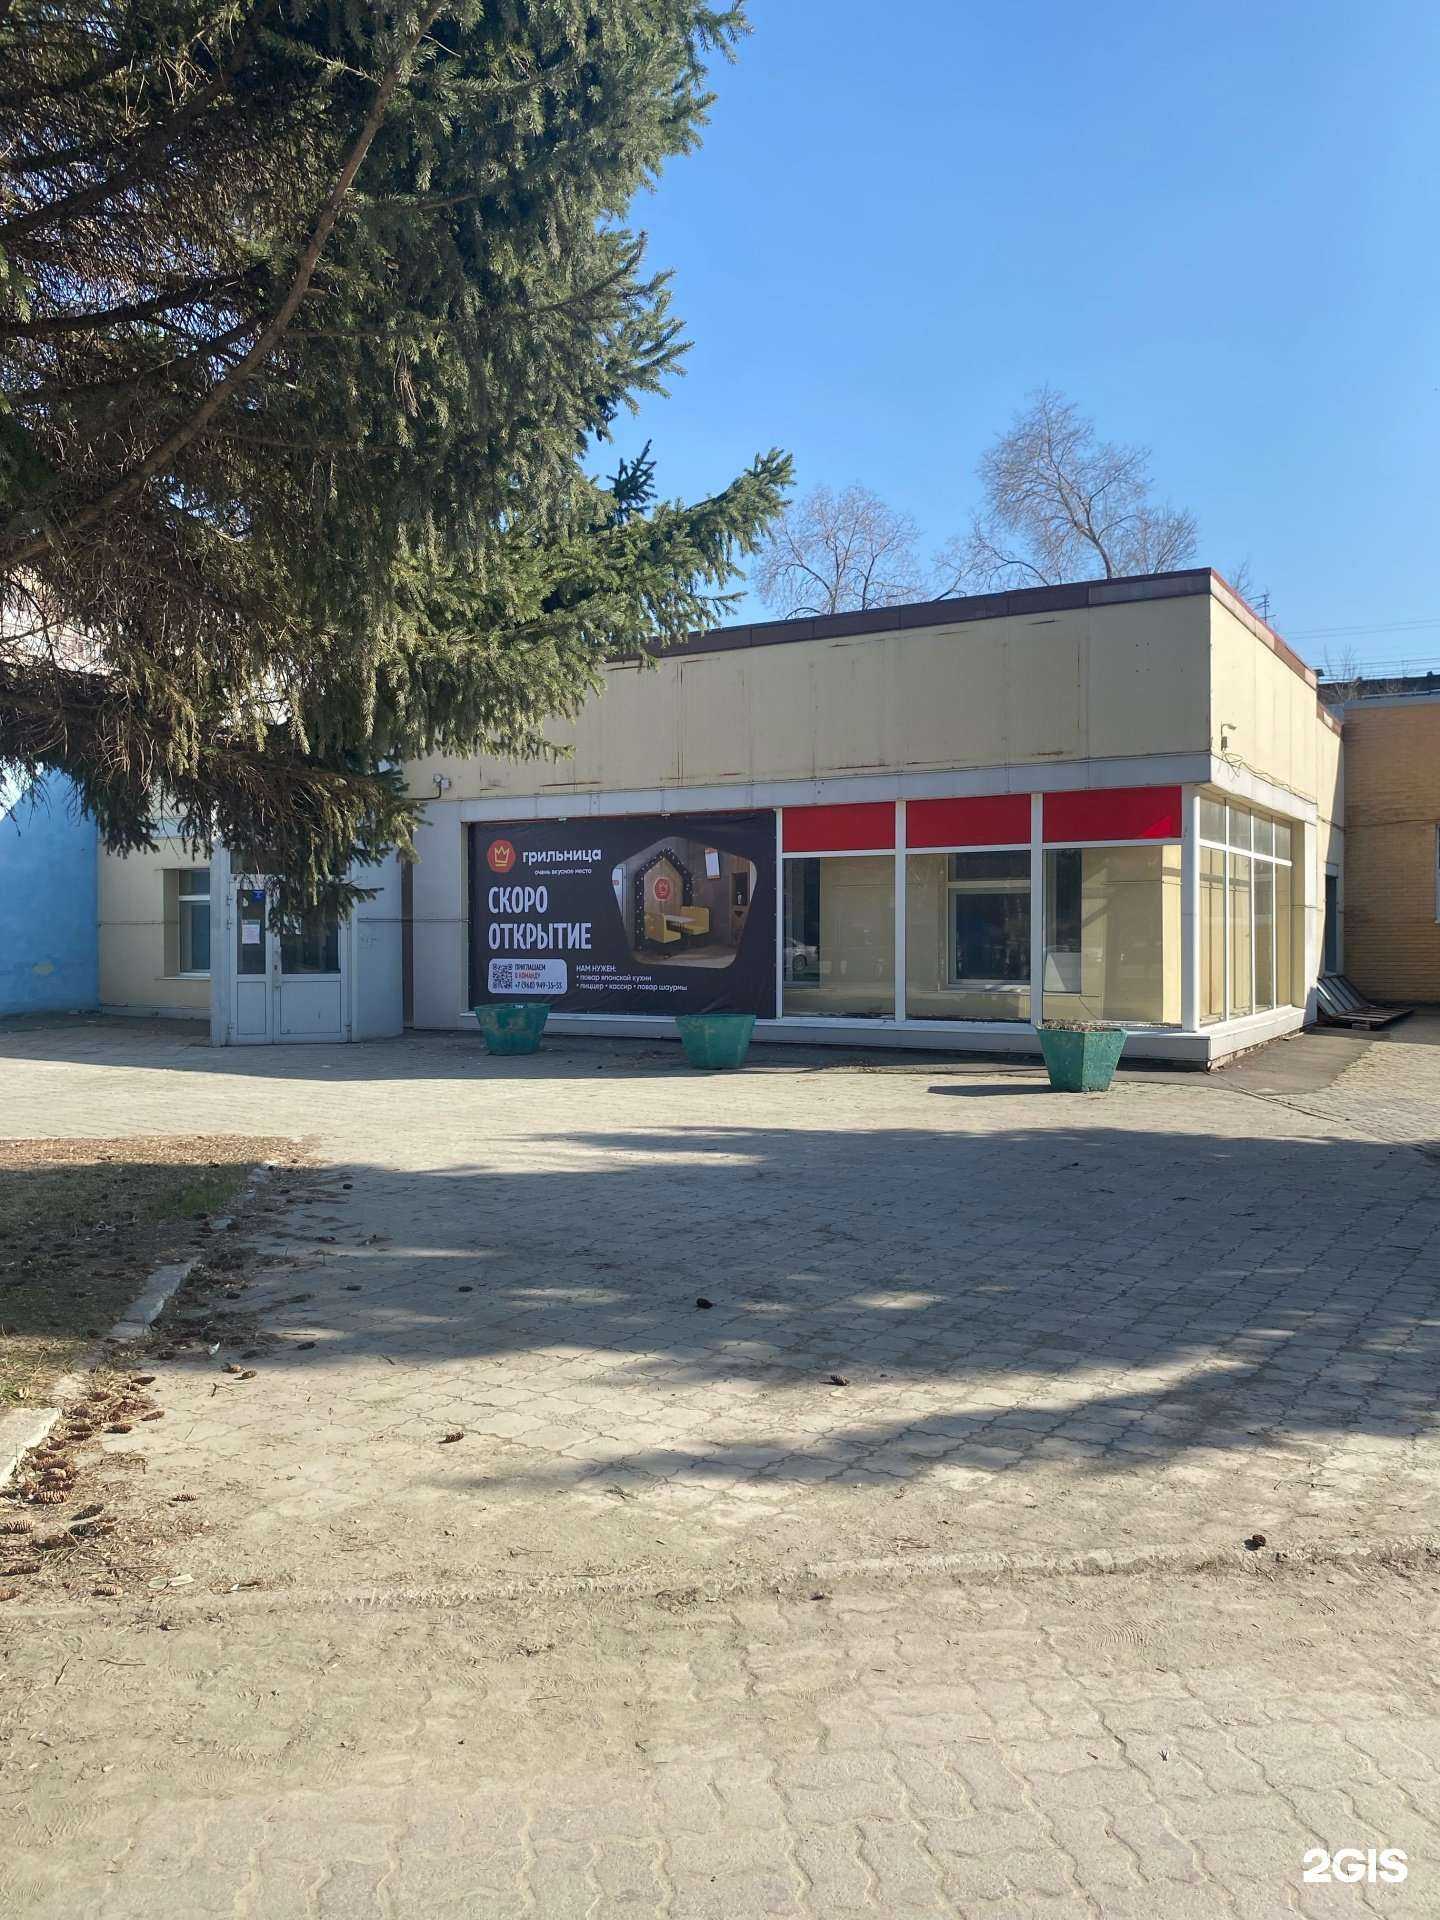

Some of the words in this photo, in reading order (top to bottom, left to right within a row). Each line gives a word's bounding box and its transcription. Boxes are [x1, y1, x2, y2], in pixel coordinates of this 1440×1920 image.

[522, 849, 602, 866] грильница
[488, 886, 548, 914] СКОРО
[488, 922, 592, 950] ОТКРЫТИЕ
[514, 963, 546, 971] ПРИГЛАШАЕМ
[576, 964, 591, 973] НАМ
[592, 964, 617, 973] НУЖЕН:
[601, 973, 631, 982] японской
[580, 983, 604, 991] пиццер
[609, 983, 632, 992] кассир
[659, 984, 688, 992] шаурмы
